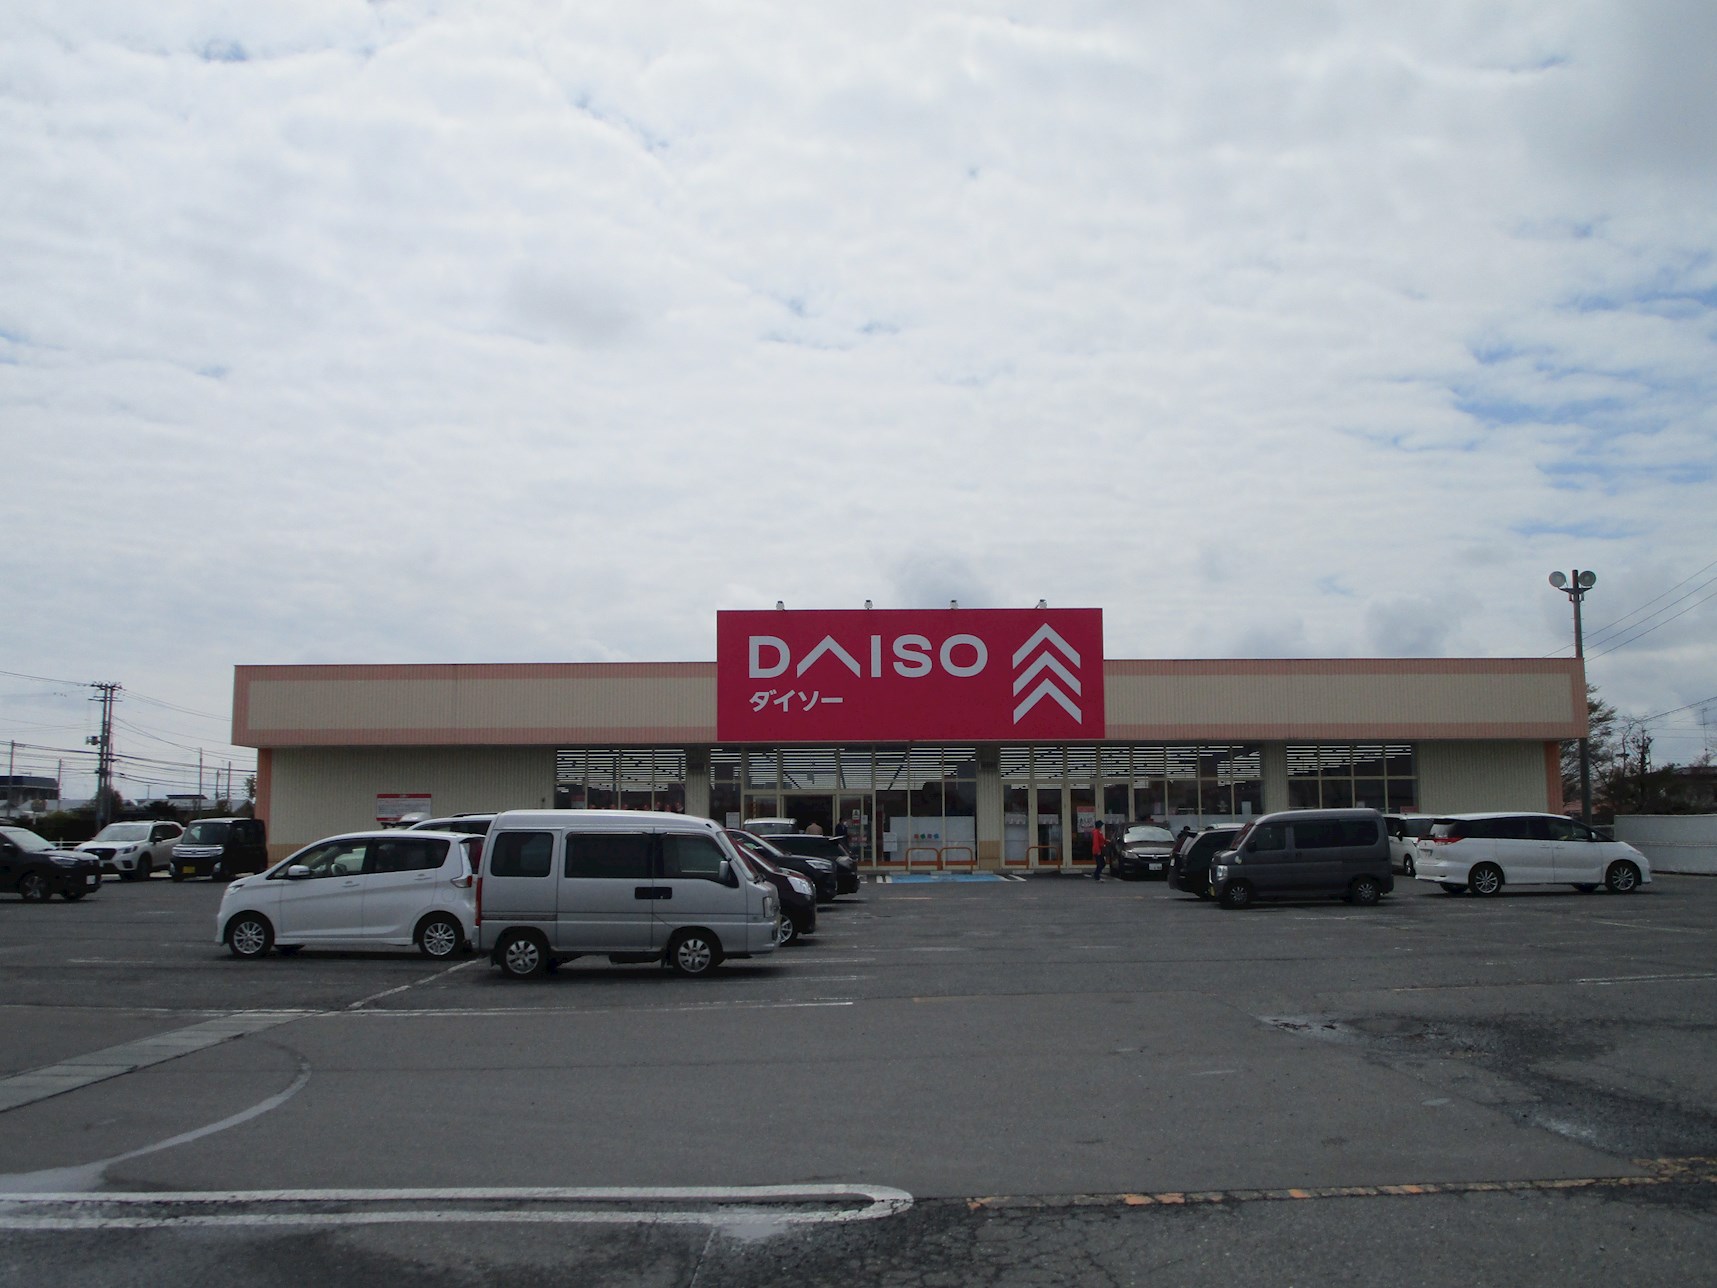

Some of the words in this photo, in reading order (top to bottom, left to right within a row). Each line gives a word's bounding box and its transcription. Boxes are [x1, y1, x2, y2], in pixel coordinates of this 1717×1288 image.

[748, 634, 988, 678] DAISO
[749, 689, 843, 712] ダイソー
